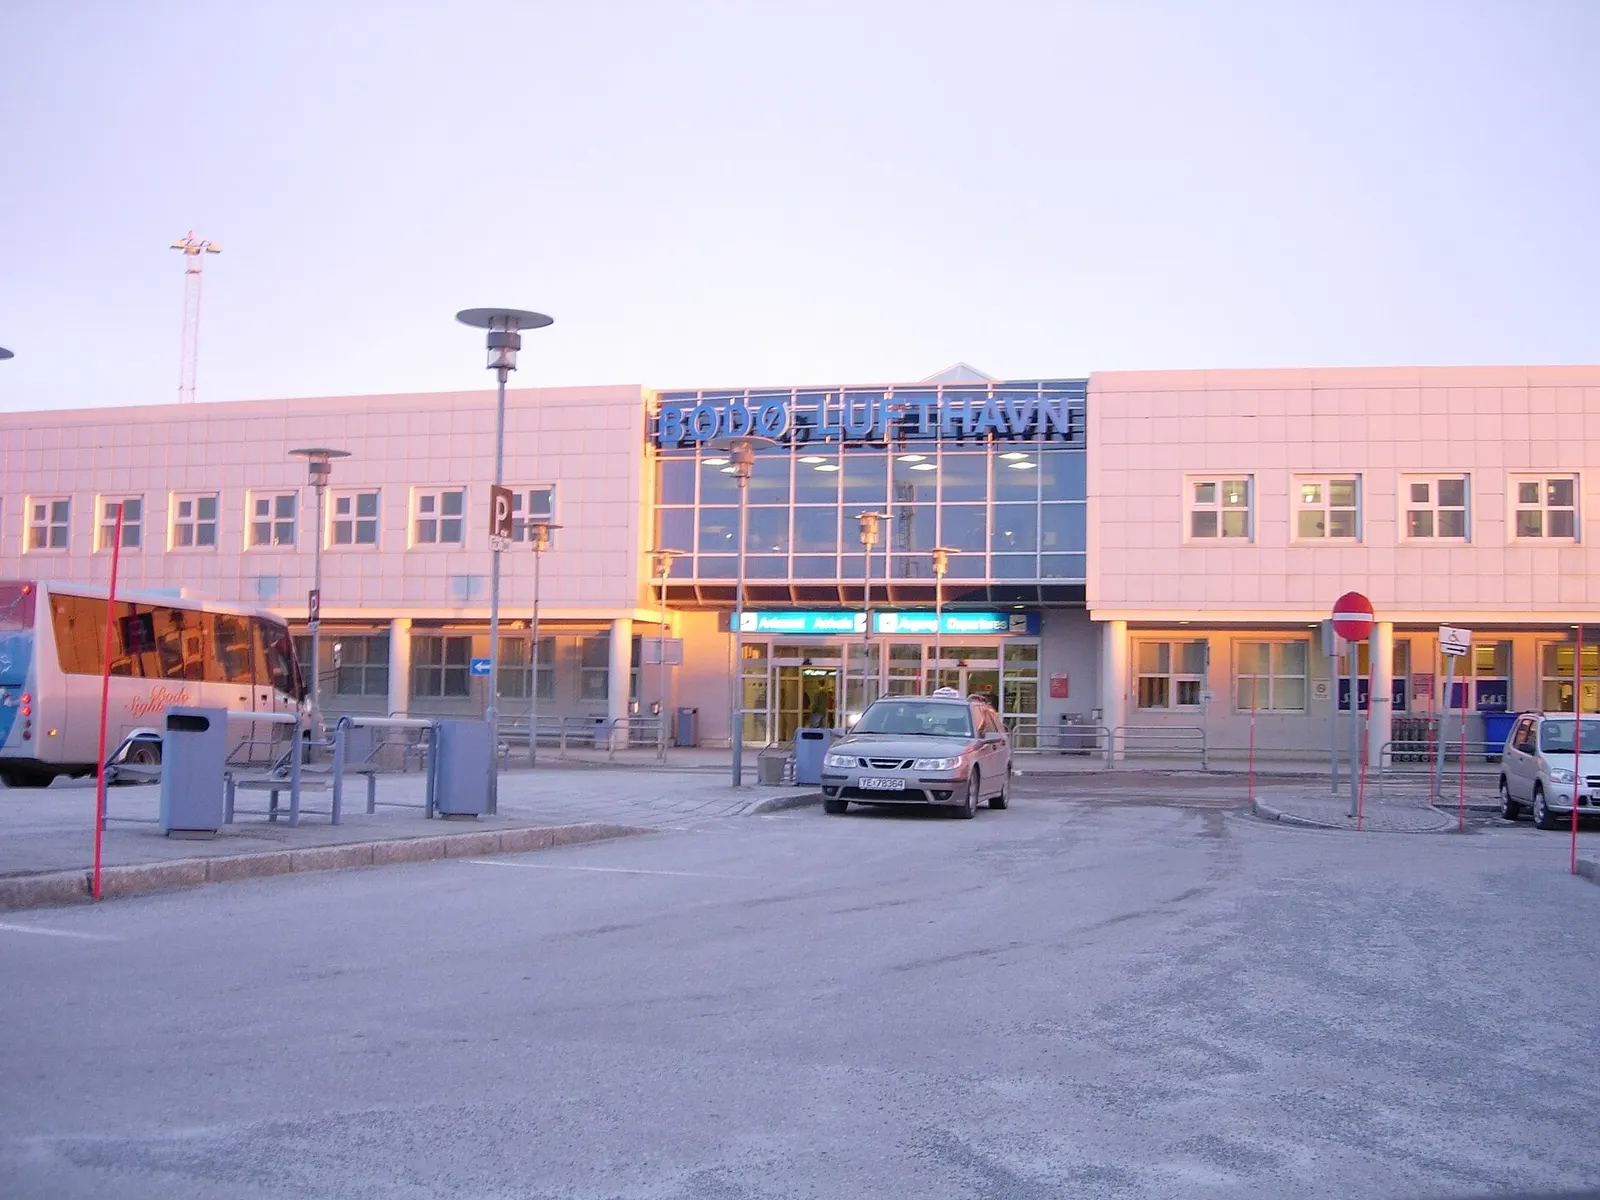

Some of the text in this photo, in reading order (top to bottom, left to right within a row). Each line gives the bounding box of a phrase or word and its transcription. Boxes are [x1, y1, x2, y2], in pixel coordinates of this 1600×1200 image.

[659, 397, 1071, 441] BODØ LUFTHAVN
[495, 495, 509, 535] P
[1341, 693, 1367, 703] SS
